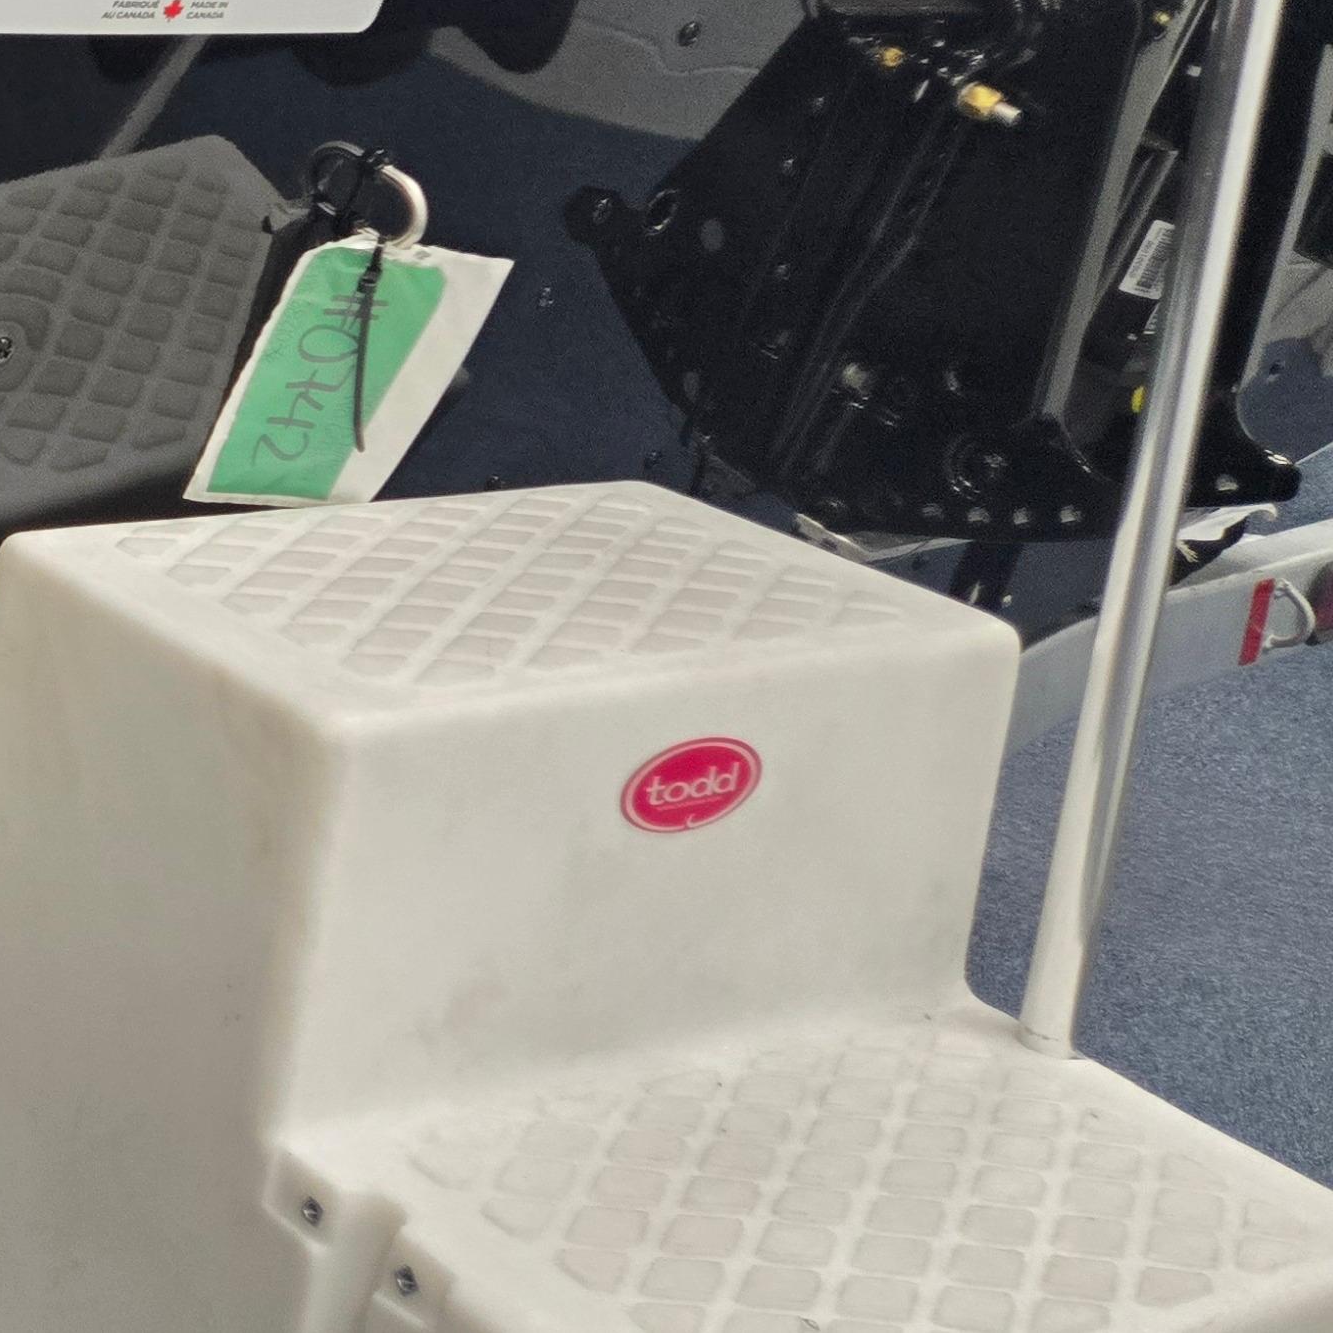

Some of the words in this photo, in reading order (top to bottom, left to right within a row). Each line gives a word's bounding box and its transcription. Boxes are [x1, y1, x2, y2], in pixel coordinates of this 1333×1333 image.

[111, 0, 161, 9] FABRIQUÉ
[190, 0, 218, 9] MADE
[219, 1, 229, 9] IN
[100, 11, 115, 19] AU
[116, 11, 156, 20] CANADA
[185, 11, 225, 20] CANADA
[645, 761, 741, 806] todd
